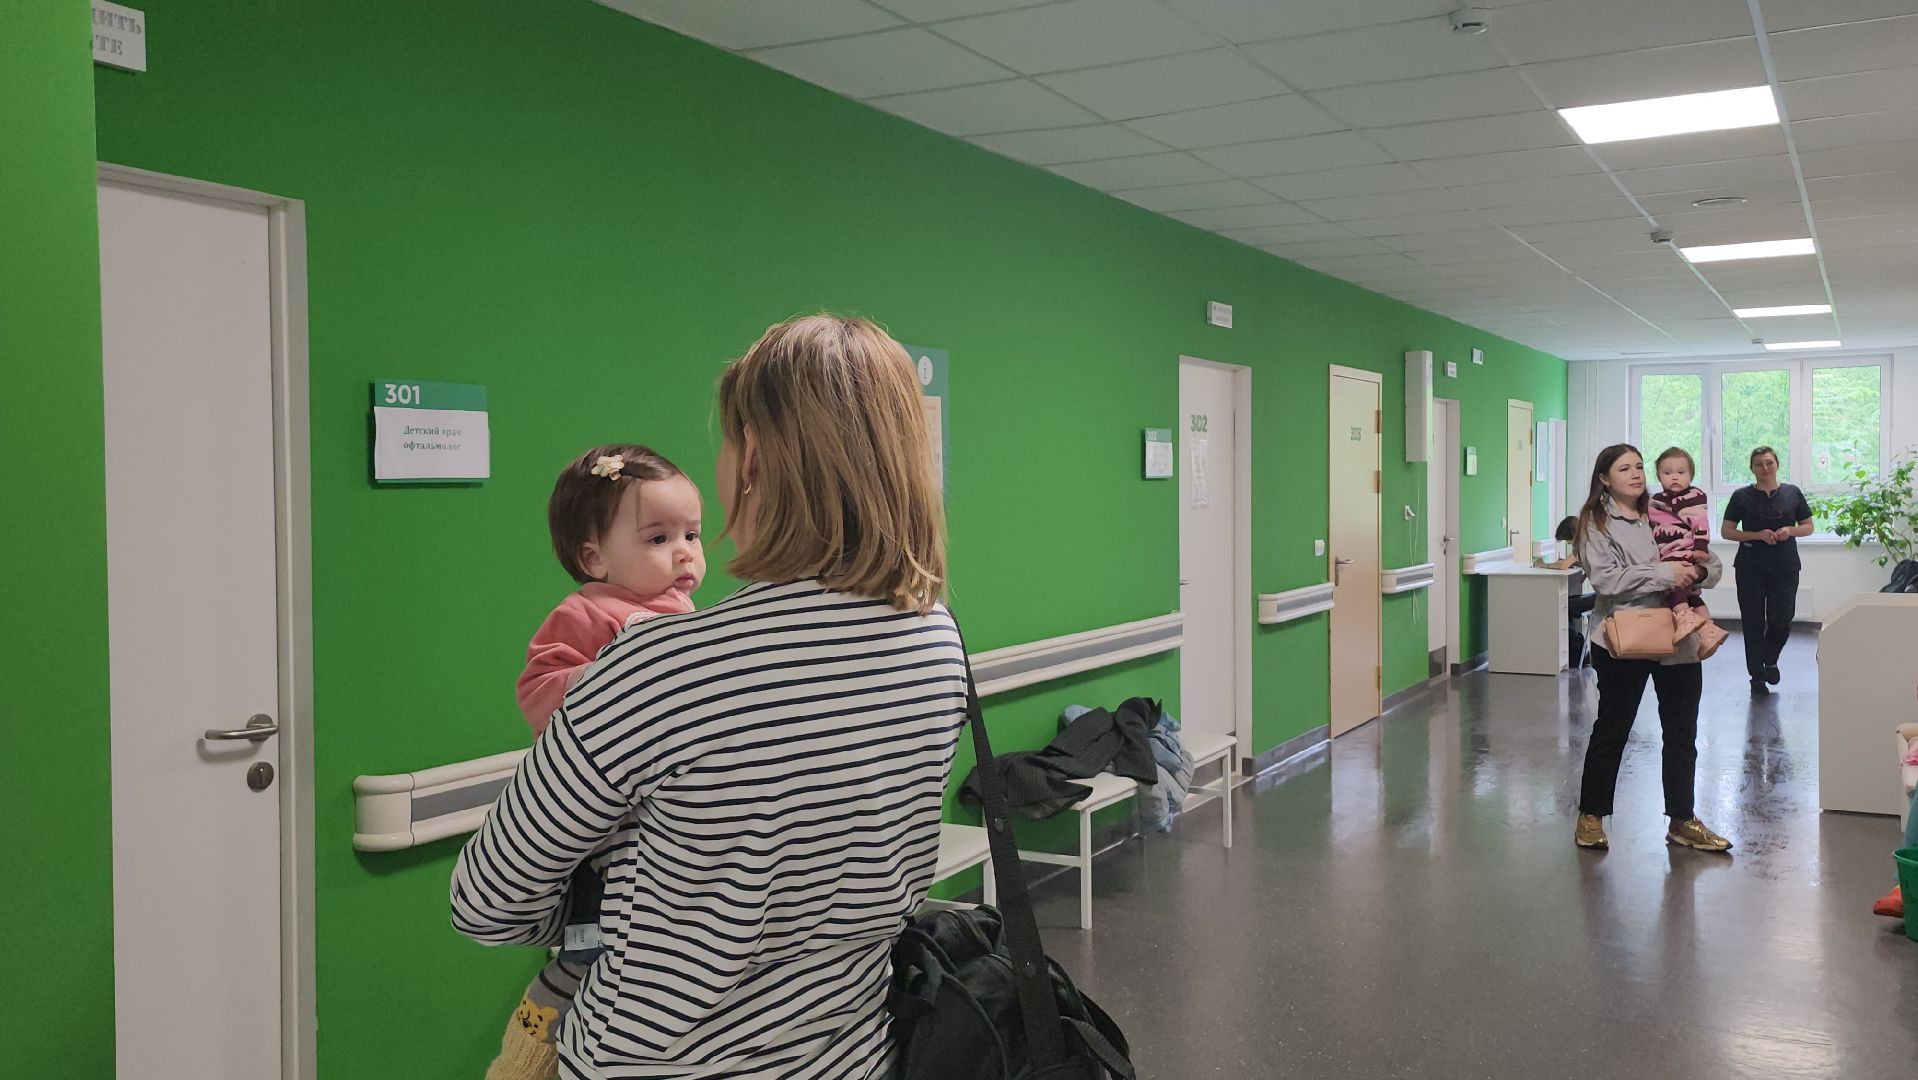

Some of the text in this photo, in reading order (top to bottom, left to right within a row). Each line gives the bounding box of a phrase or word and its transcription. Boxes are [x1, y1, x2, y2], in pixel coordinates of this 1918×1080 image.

[384, 383, 421, 405] 301
[403, 425, 462, 438] Детский врач
[1190, 414, 1208, 433] 302
[403, 441, 461, 452] офтальмолог
